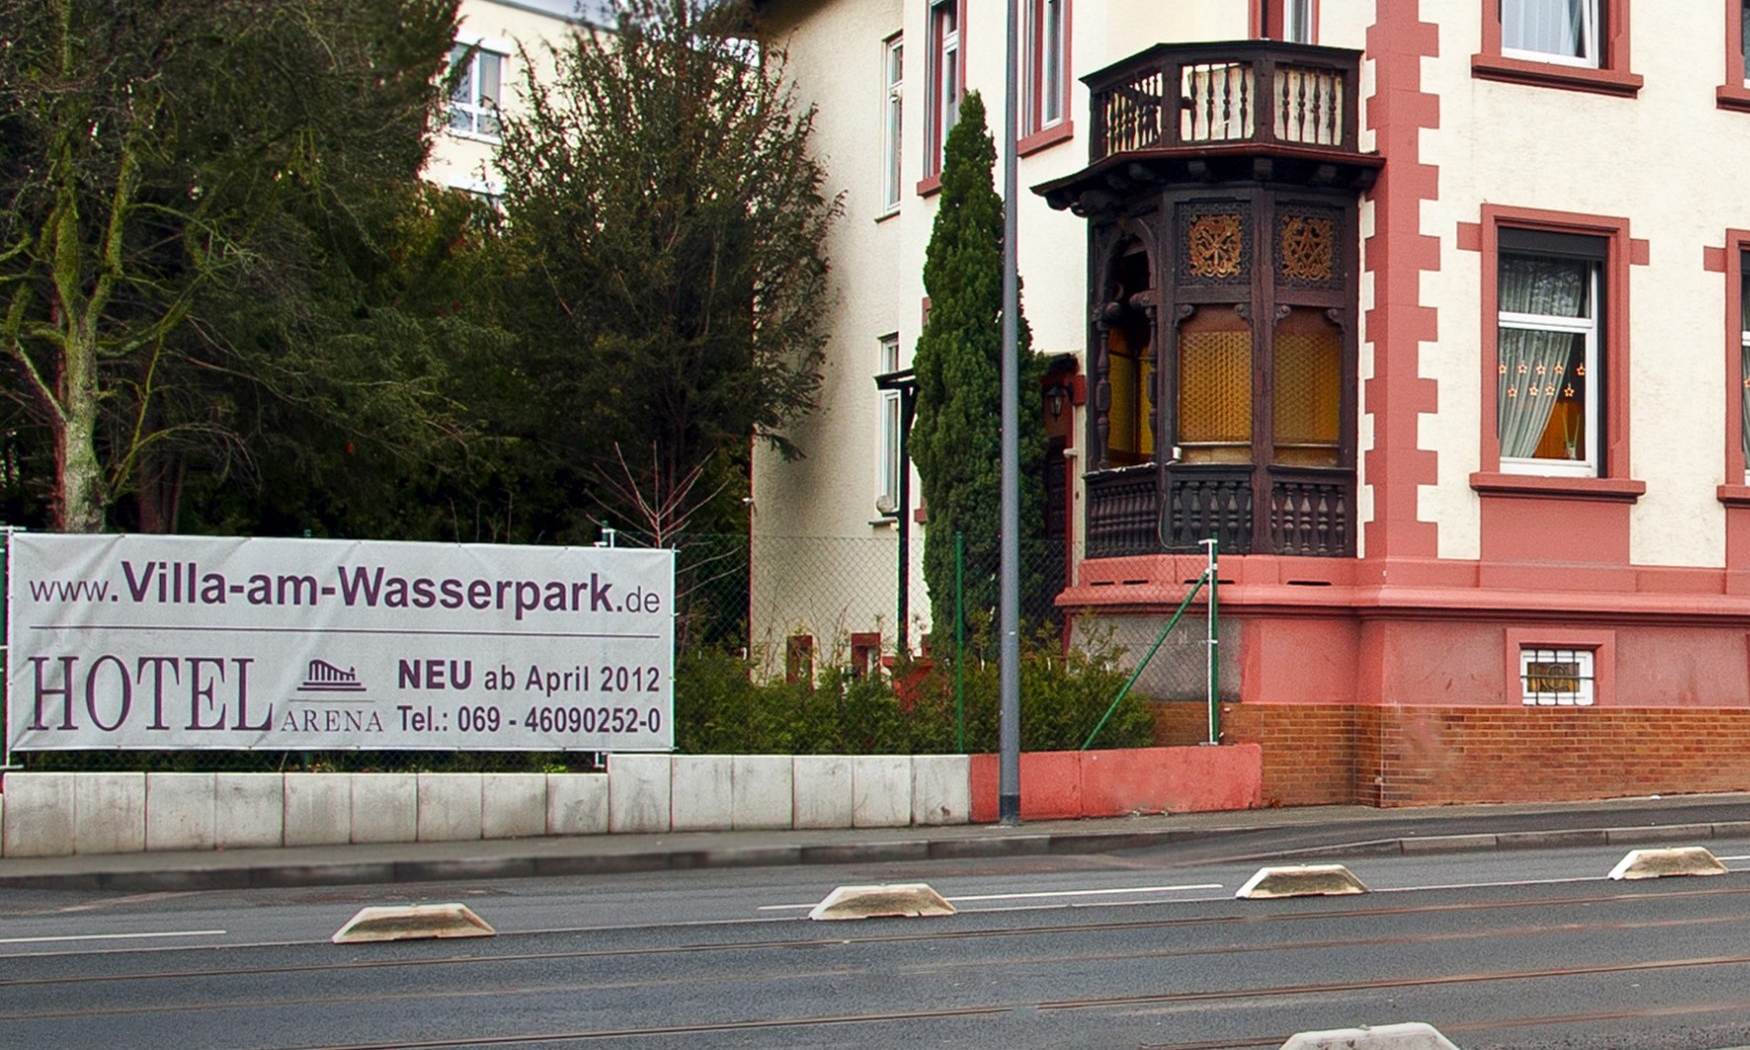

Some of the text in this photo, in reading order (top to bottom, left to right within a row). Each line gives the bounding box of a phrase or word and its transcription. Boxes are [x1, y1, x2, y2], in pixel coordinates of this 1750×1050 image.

[29, 561, 660, 621] www.Villa-am-Wasserpark.de
[26, 654, 273, 732] HOTEL
[398, 659, 660, 697] NEU ab April 2012
[280, 709, 384, 732] ARENA
[396, 705, 448, 732] Tel.:
[458, 706, 500, 732] 069
[524, 706, 661, 733] 46090252-0
